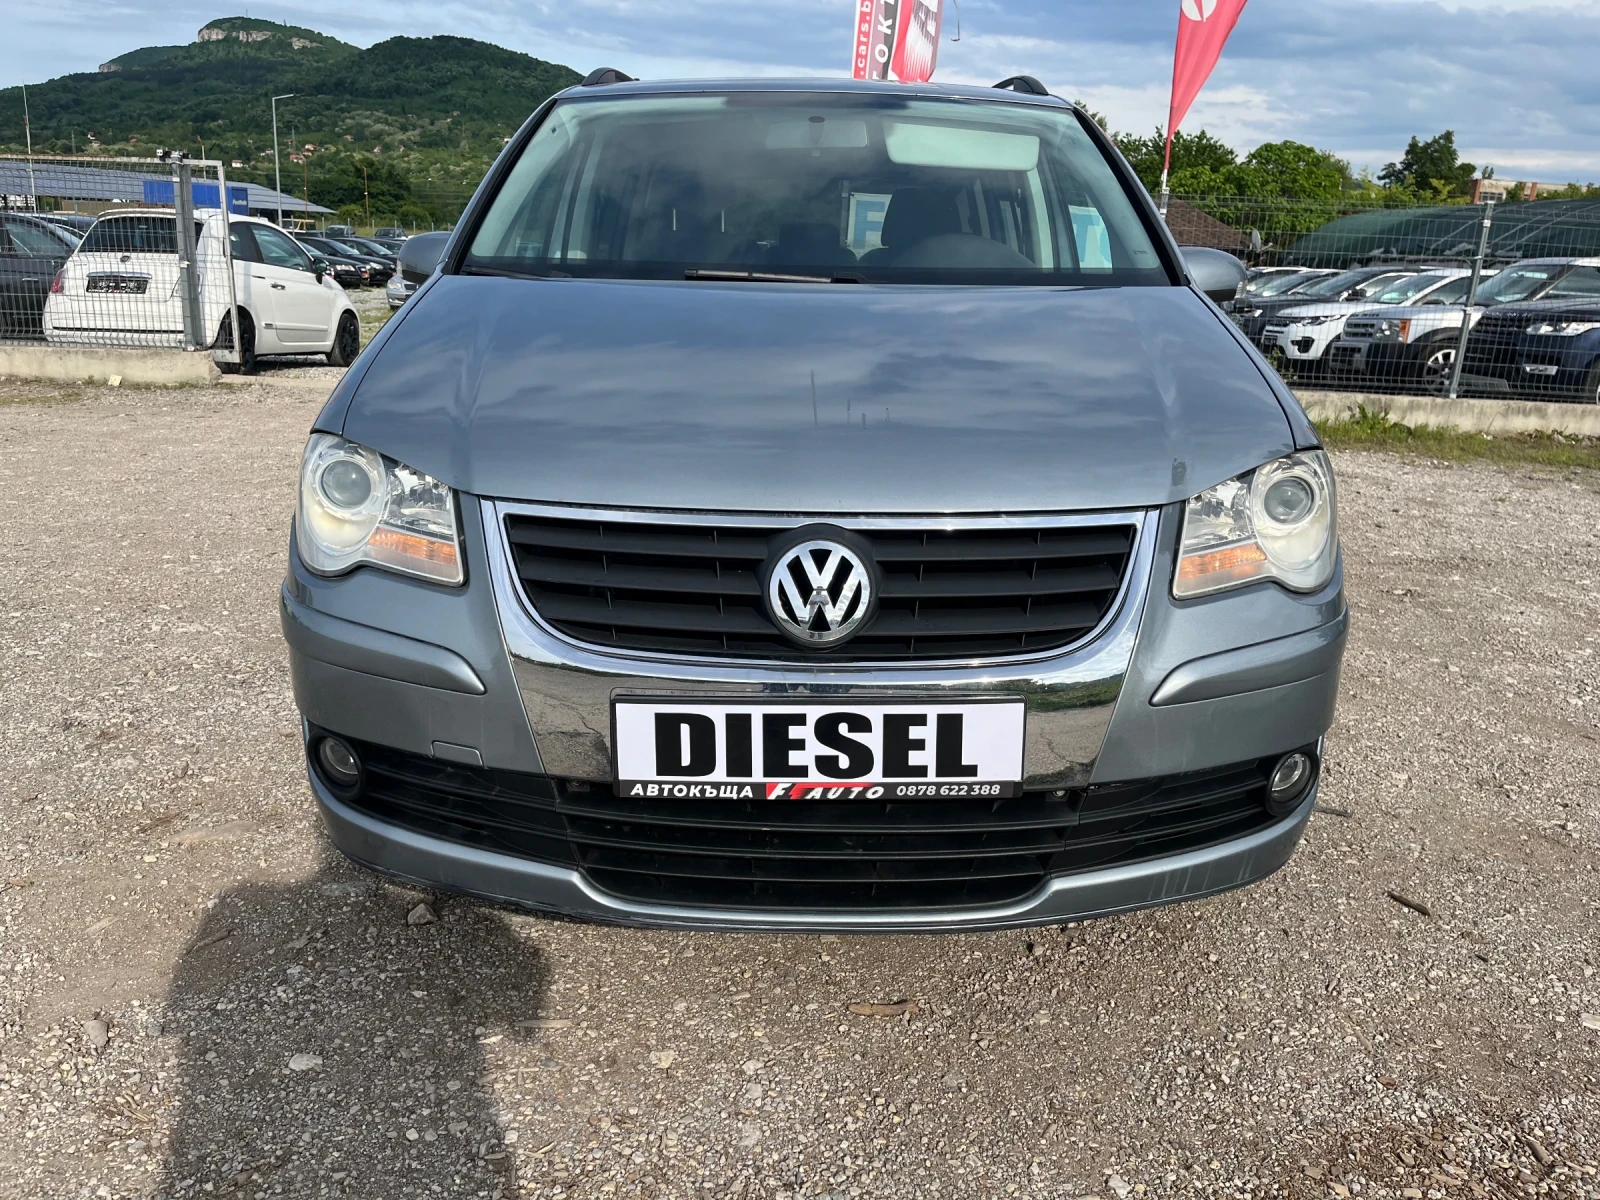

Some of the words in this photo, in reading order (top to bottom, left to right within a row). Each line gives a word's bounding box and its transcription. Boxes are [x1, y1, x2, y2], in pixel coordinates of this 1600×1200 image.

[654, 711, 979, 780] DIESEL
[630, 783, 754, 799] АВТОКЪЩА
[896, 784, 936, 797] 0878
[939, 784, 968, 796] 622
[970, 783, 1001, 795] 388
